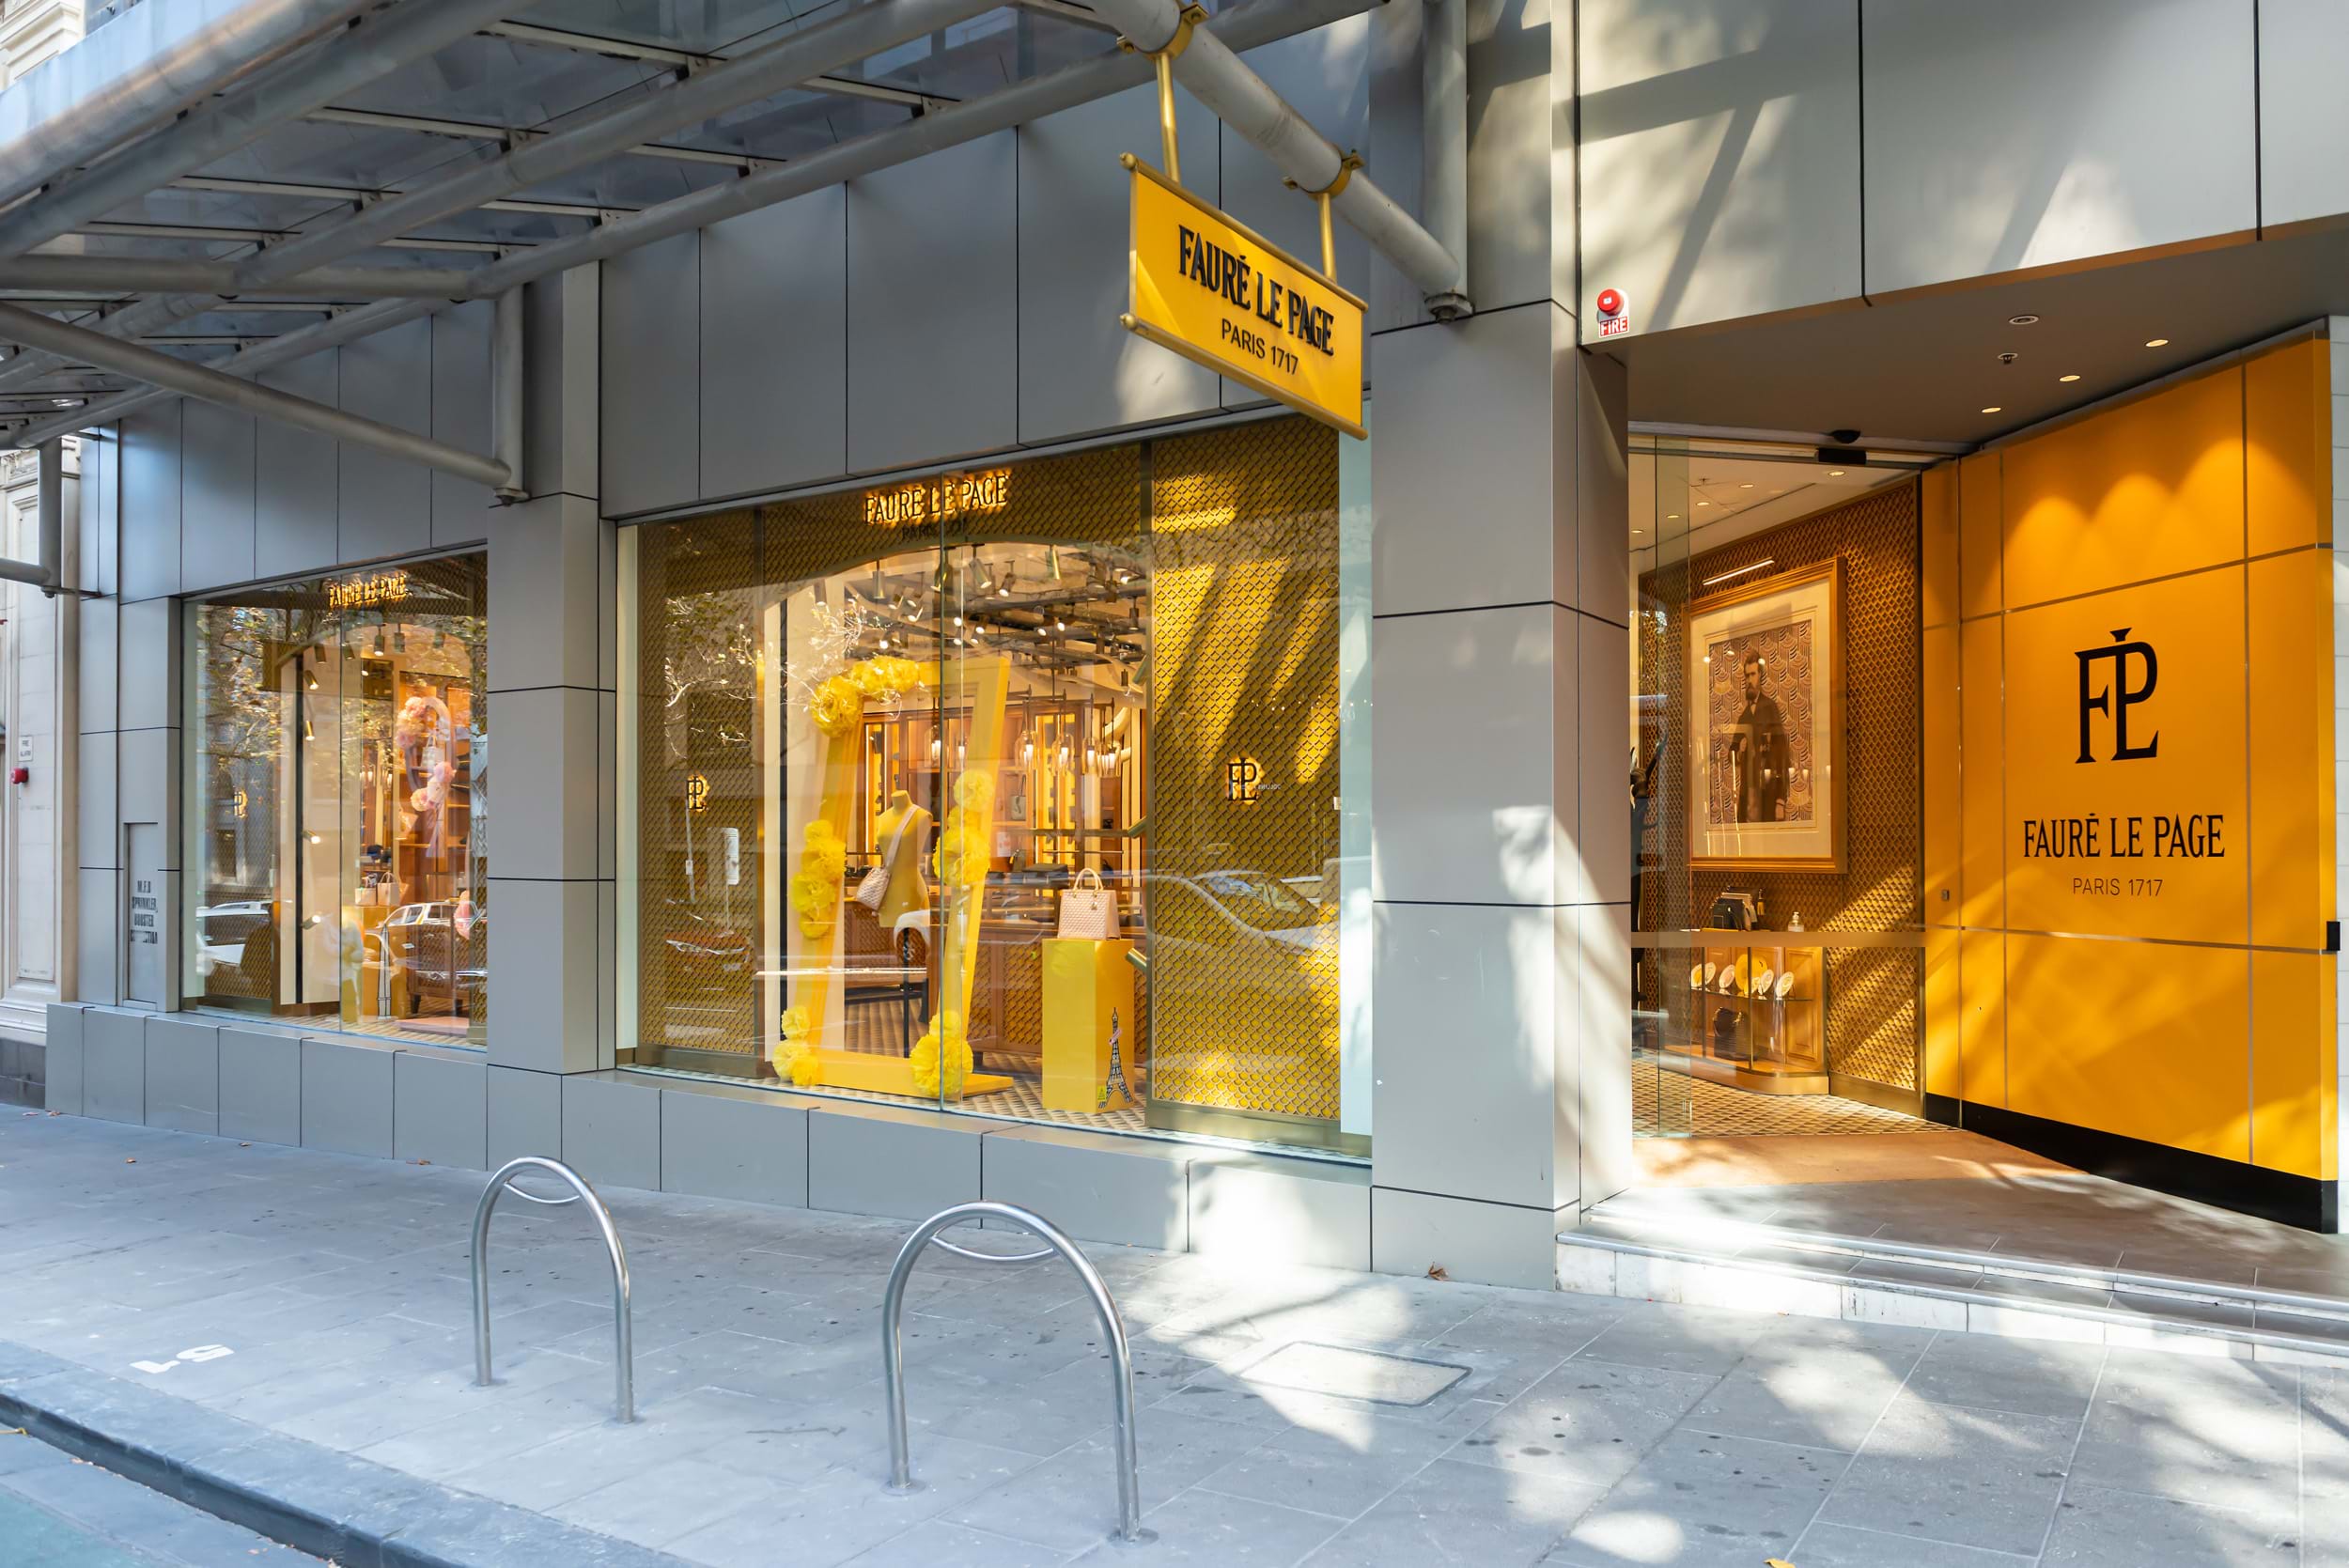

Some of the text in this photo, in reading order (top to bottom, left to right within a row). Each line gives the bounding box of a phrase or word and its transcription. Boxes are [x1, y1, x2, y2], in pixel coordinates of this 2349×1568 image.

[1255, 271, 1283, 329] LE
[1288, 289, 1334, 356] PAGE
[1601, 318, 1627, 335] FIRE
[1221, 318, 1299, 375] PARIS 1717
[930, 483, 957, 514] LE
[961, 474, 1009, 509] PAGE
[2110, 816, 2143, 858] LE
[2154, 814, 2225, 859] PAGE
[2073, 877, 2163, 896] PARIS 1717
